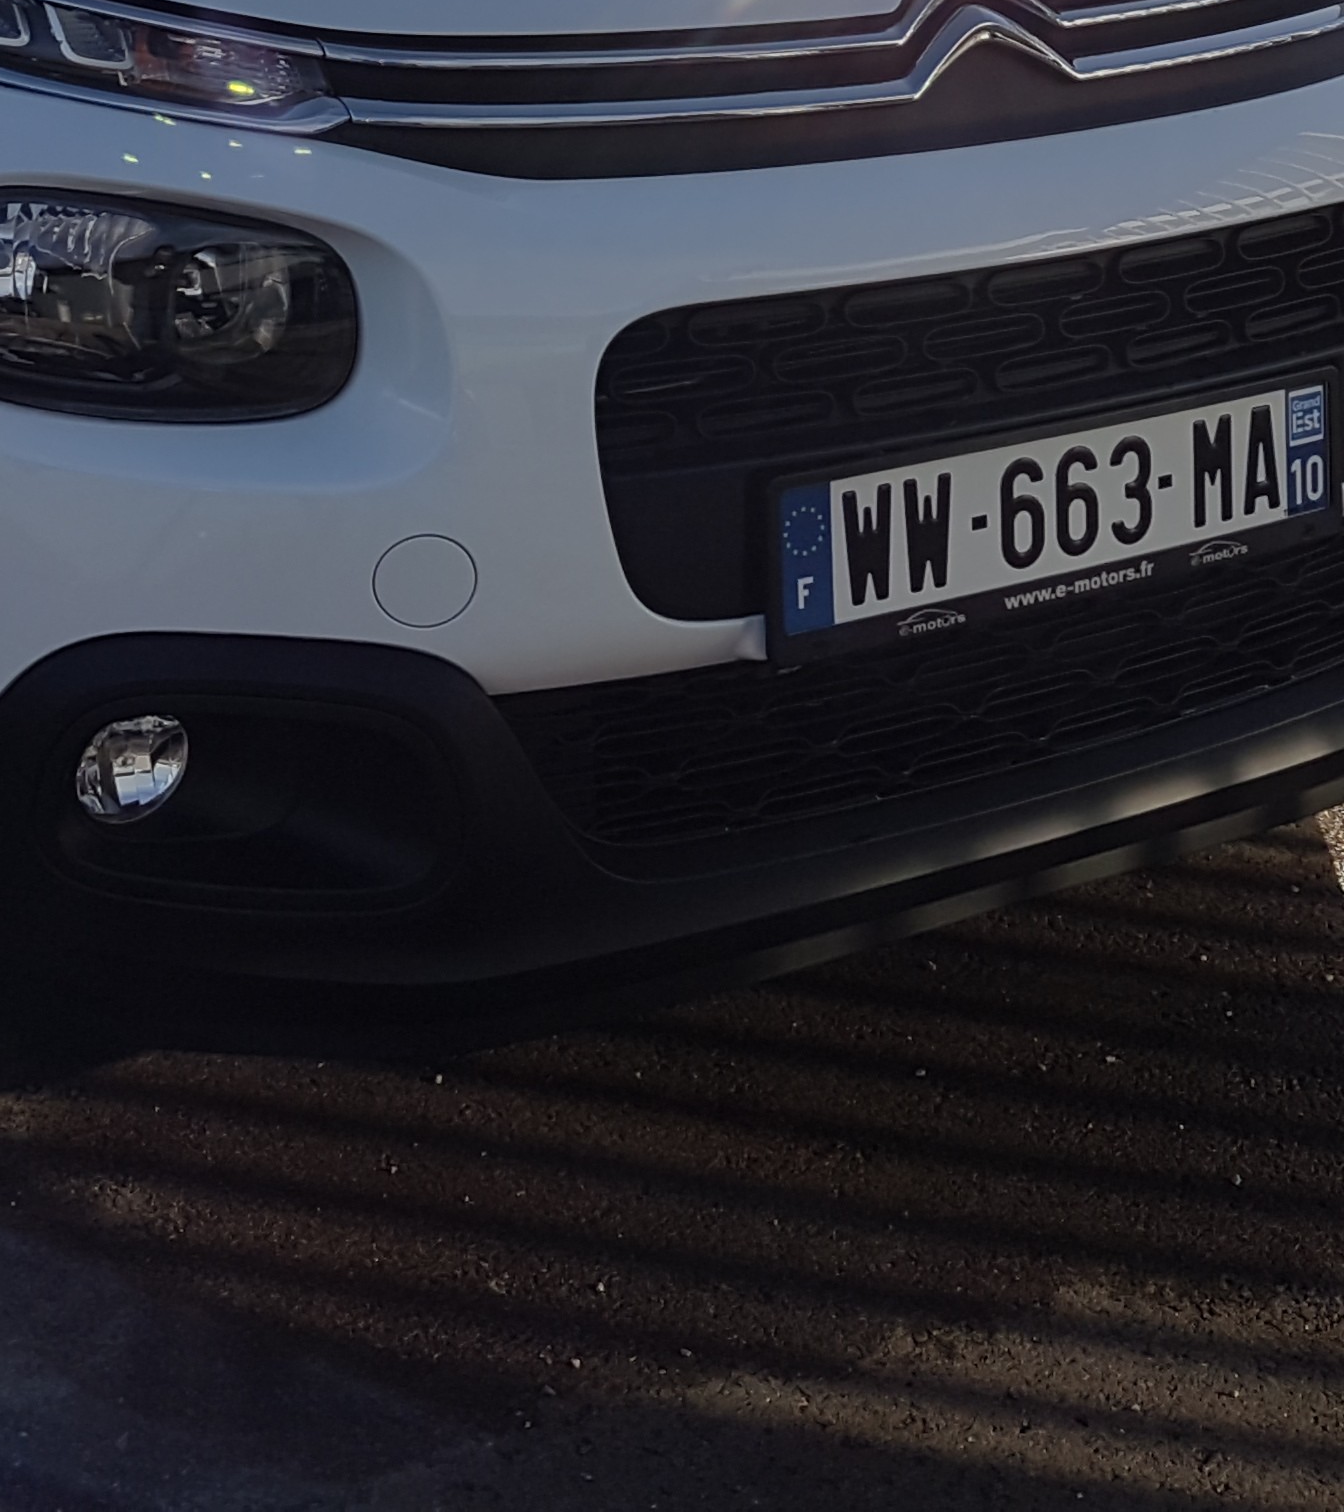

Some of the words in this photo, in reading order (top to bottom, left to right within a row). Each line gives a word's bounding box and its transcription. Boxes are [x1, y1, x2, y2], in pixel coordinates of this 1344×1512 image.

[1292, 395, 1321, 411] Grand
[1292, 408, 1321, 434] Est
[1290, 455, 1324, 505] 10
[842, 404, 1282, 607] WW-663-MA
[797, 576, 815, 610] F
[1004, 560, 1155, 610] www.e-motors.fr
